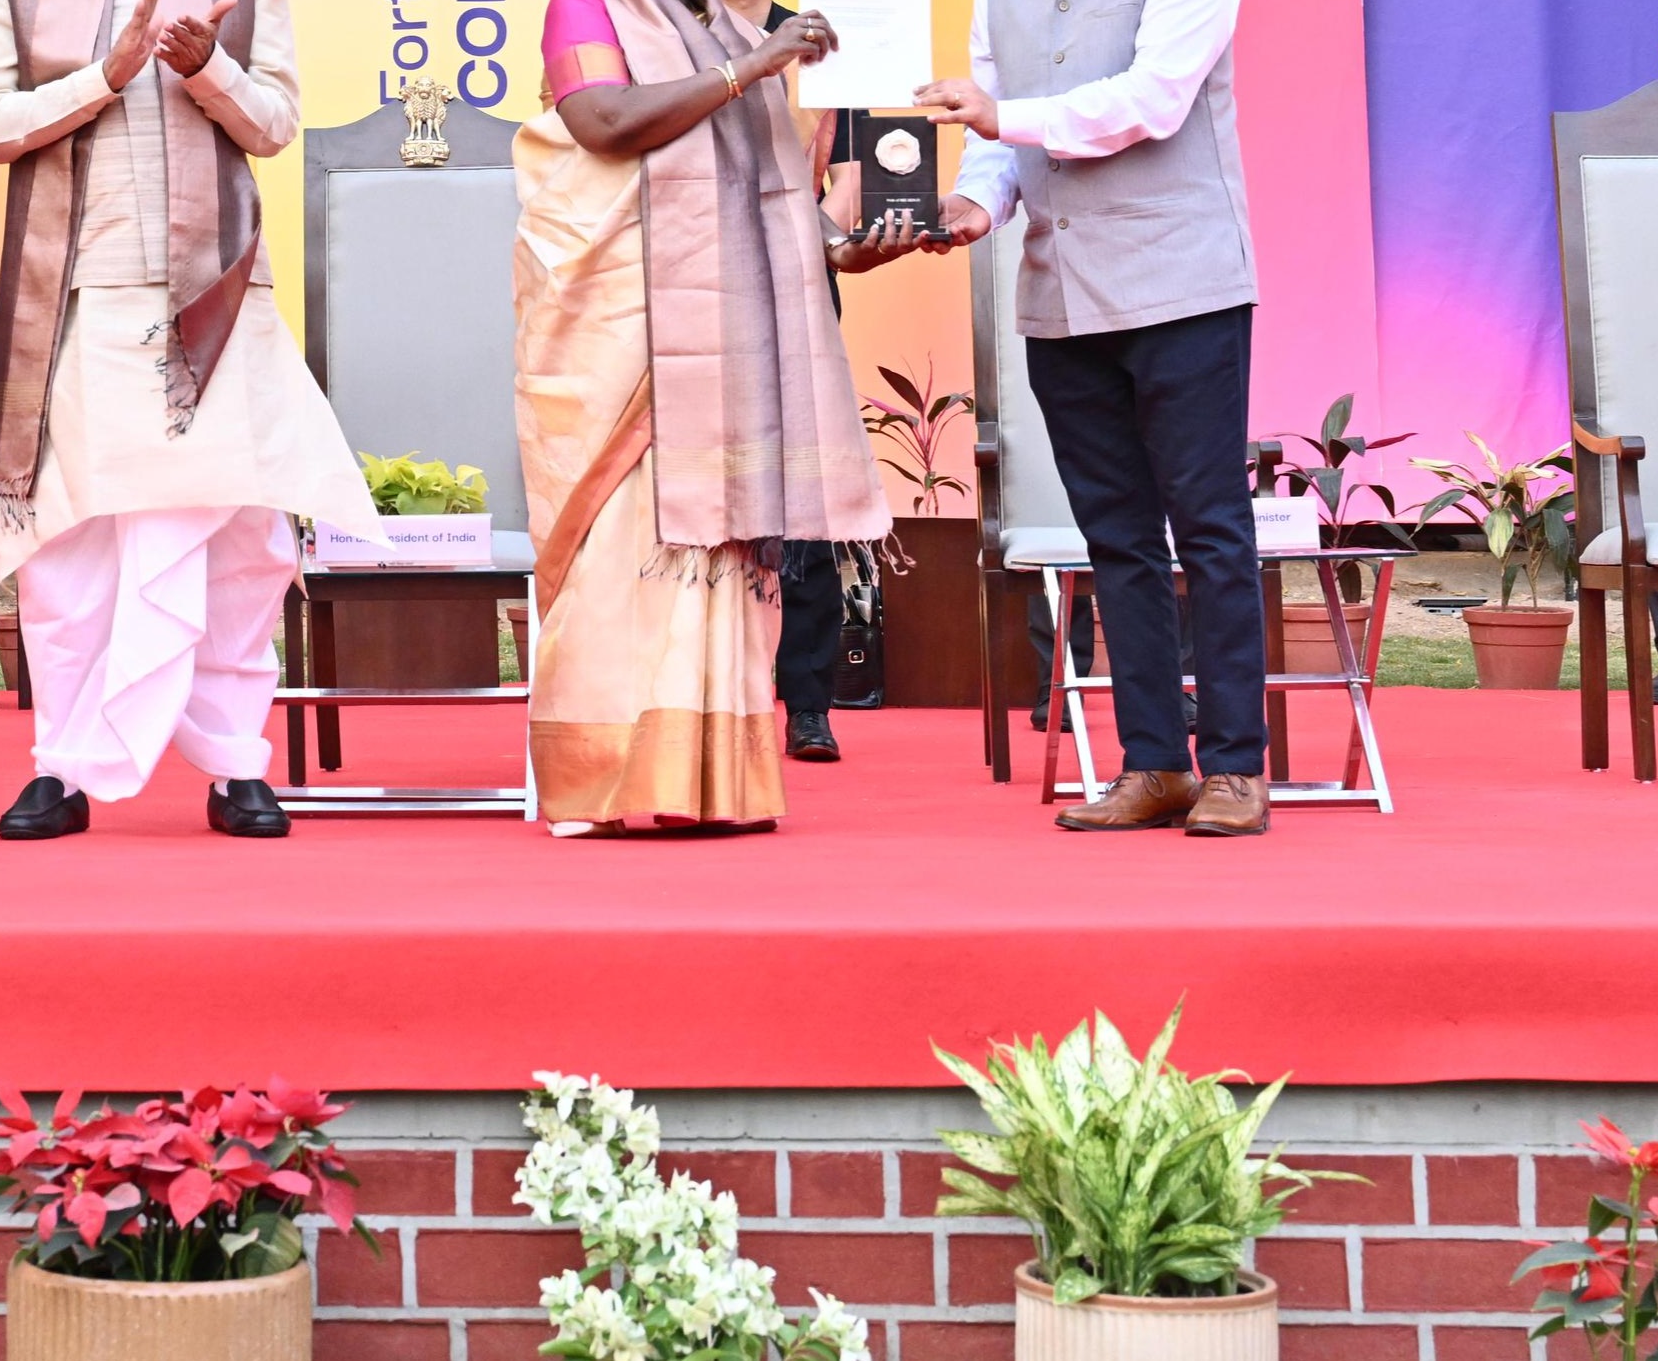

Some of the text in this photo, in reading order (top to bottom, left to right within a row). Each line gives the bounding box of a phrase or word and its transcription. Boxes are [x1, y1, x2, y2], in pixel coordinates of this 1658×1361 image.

[1255, 512, 1291, 522] inister
[432, 533, 443, 543] of
[447, 532, 476, 542] India
